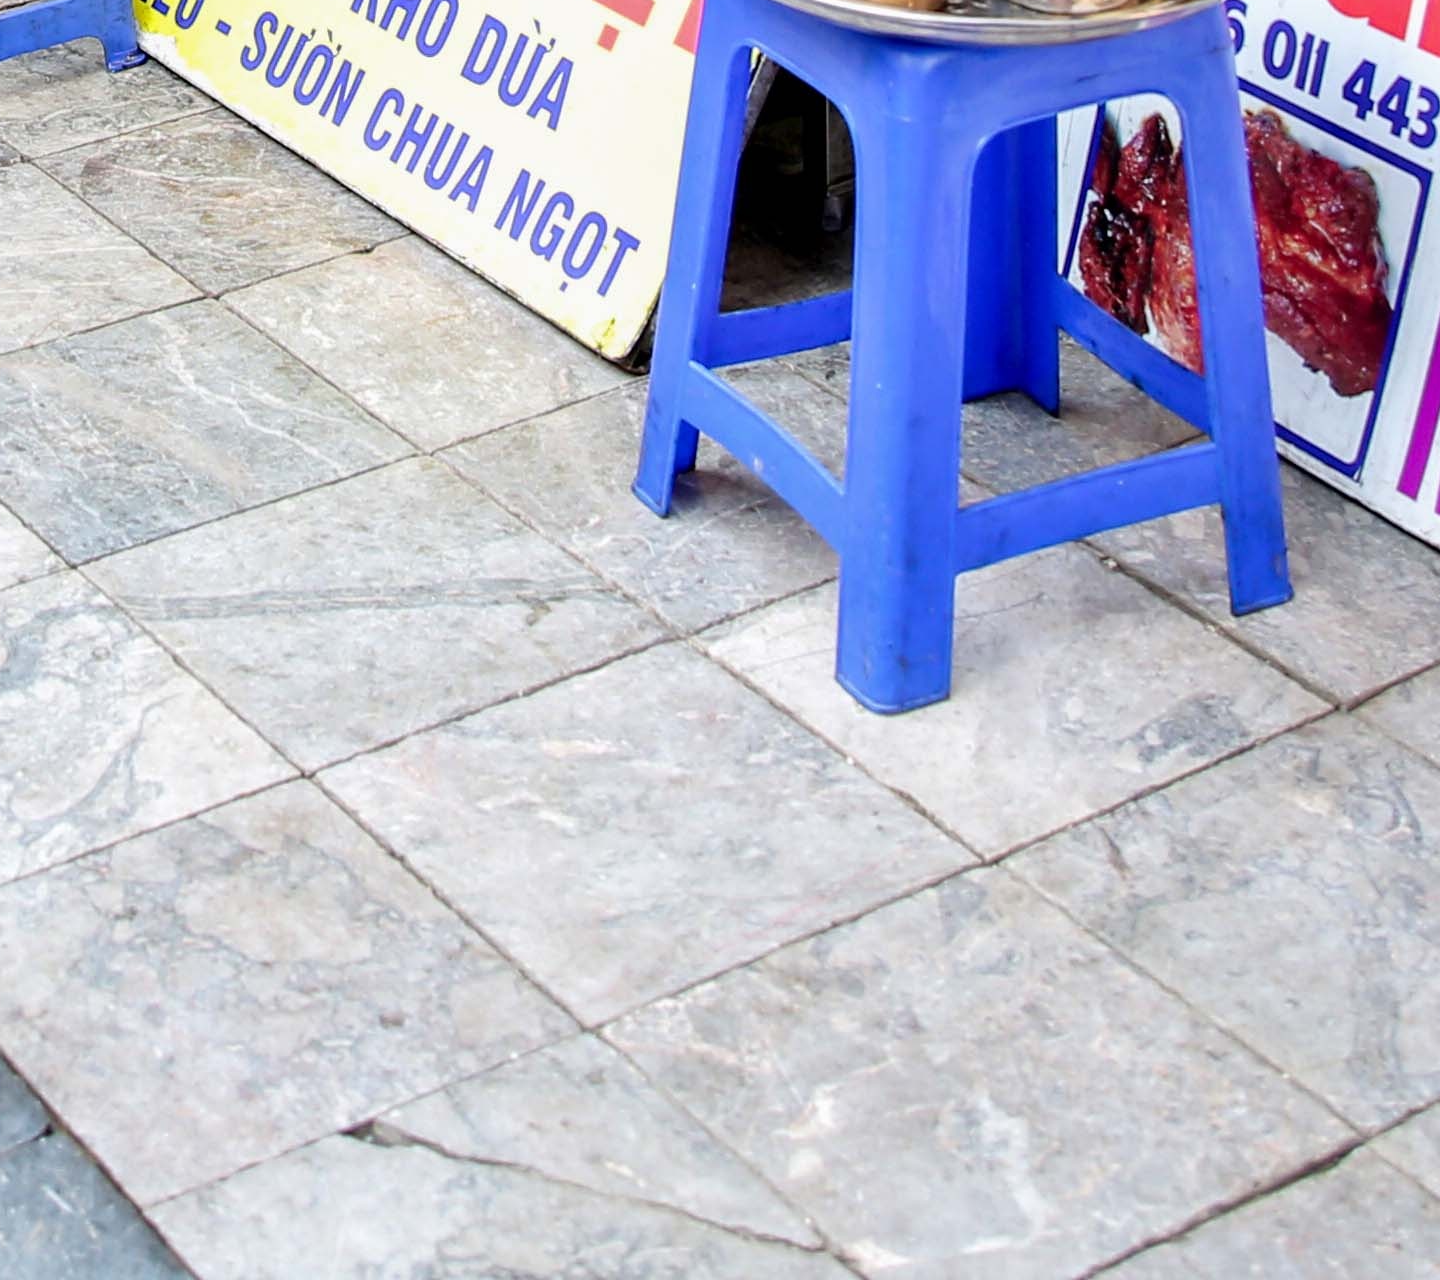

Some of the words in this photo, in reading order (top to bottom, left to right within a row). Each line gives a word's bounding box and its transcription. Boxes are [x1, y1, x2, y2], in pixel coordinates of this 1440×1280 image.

[239, 9, 366, 128] SƯỜN
[363, 86, 494, 215] CHUA
[494, 169, 641, 299] NGỌT
[461, 17, 576, 132] DỪA
